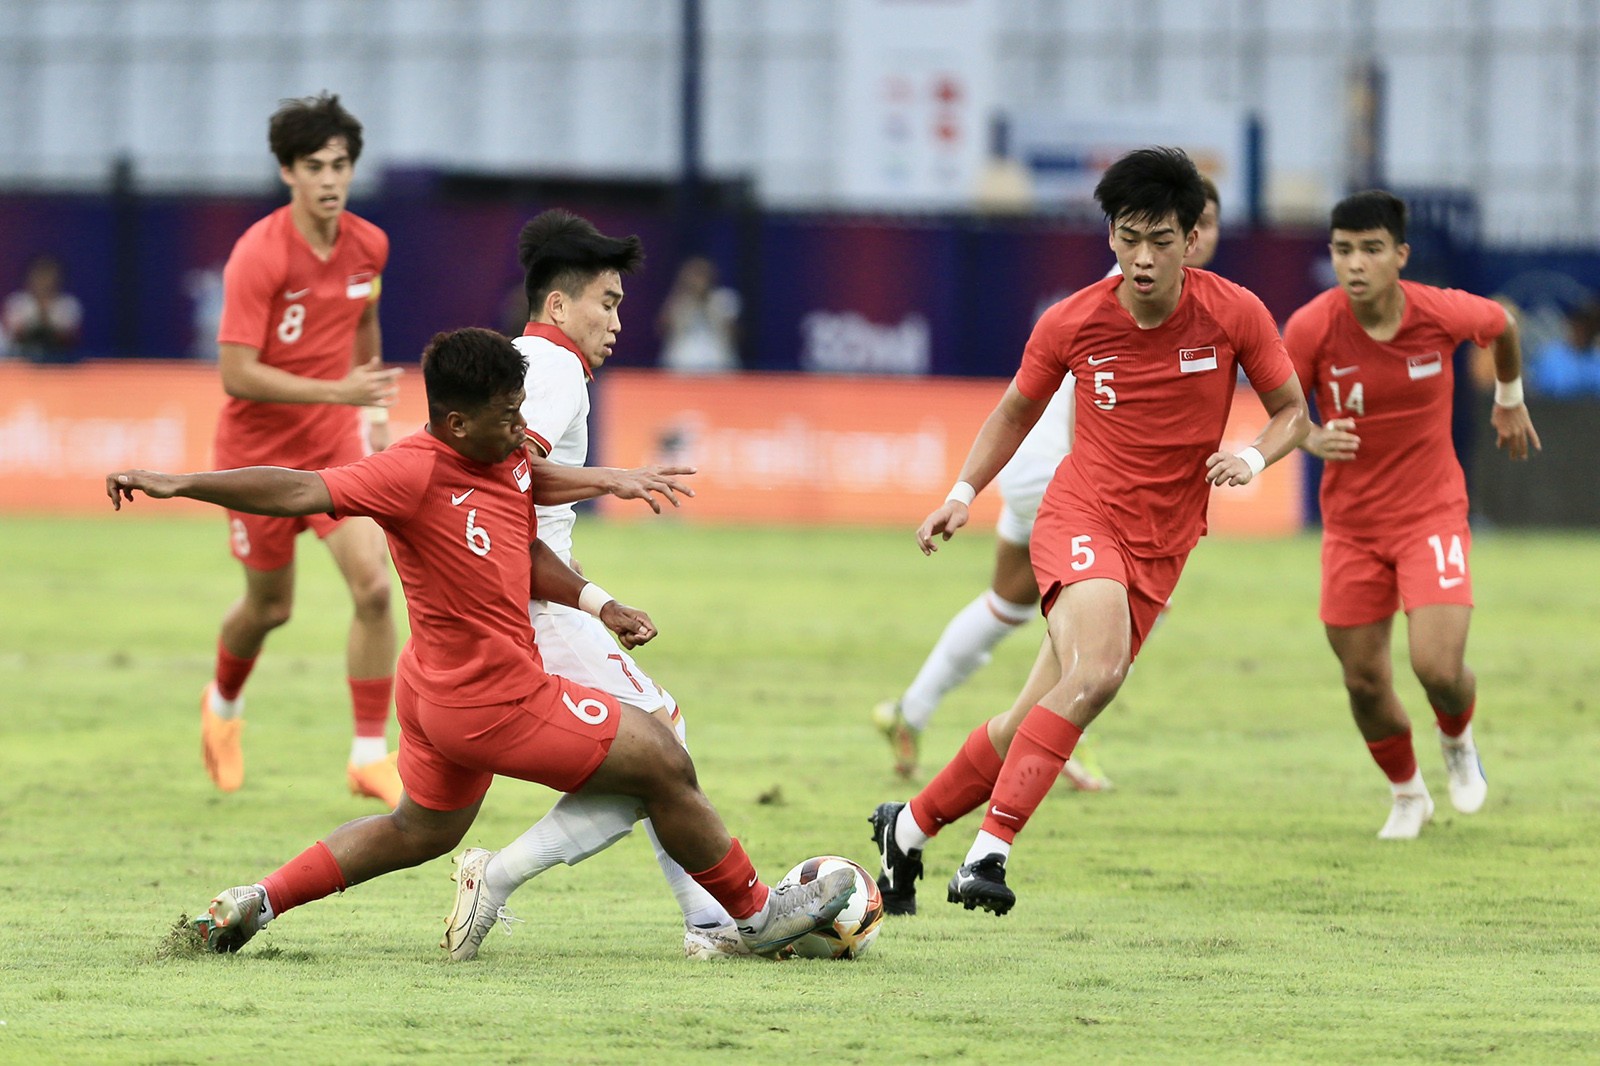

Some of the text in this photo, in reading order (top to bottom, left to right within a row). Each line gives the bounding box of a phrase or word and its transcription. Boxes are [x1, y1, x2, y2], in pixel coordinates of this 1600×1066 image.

[277, 303, 306, 343] 8
[1093, 371, 1117, 411] 5
[1327, 380, 1365, 417] 14
[465, 508, 491, 557] 6
[1070, 534, 1096, 572] 5
[1427, 533, 1466, 576] 14
[561, 690, 609, 726] 6
